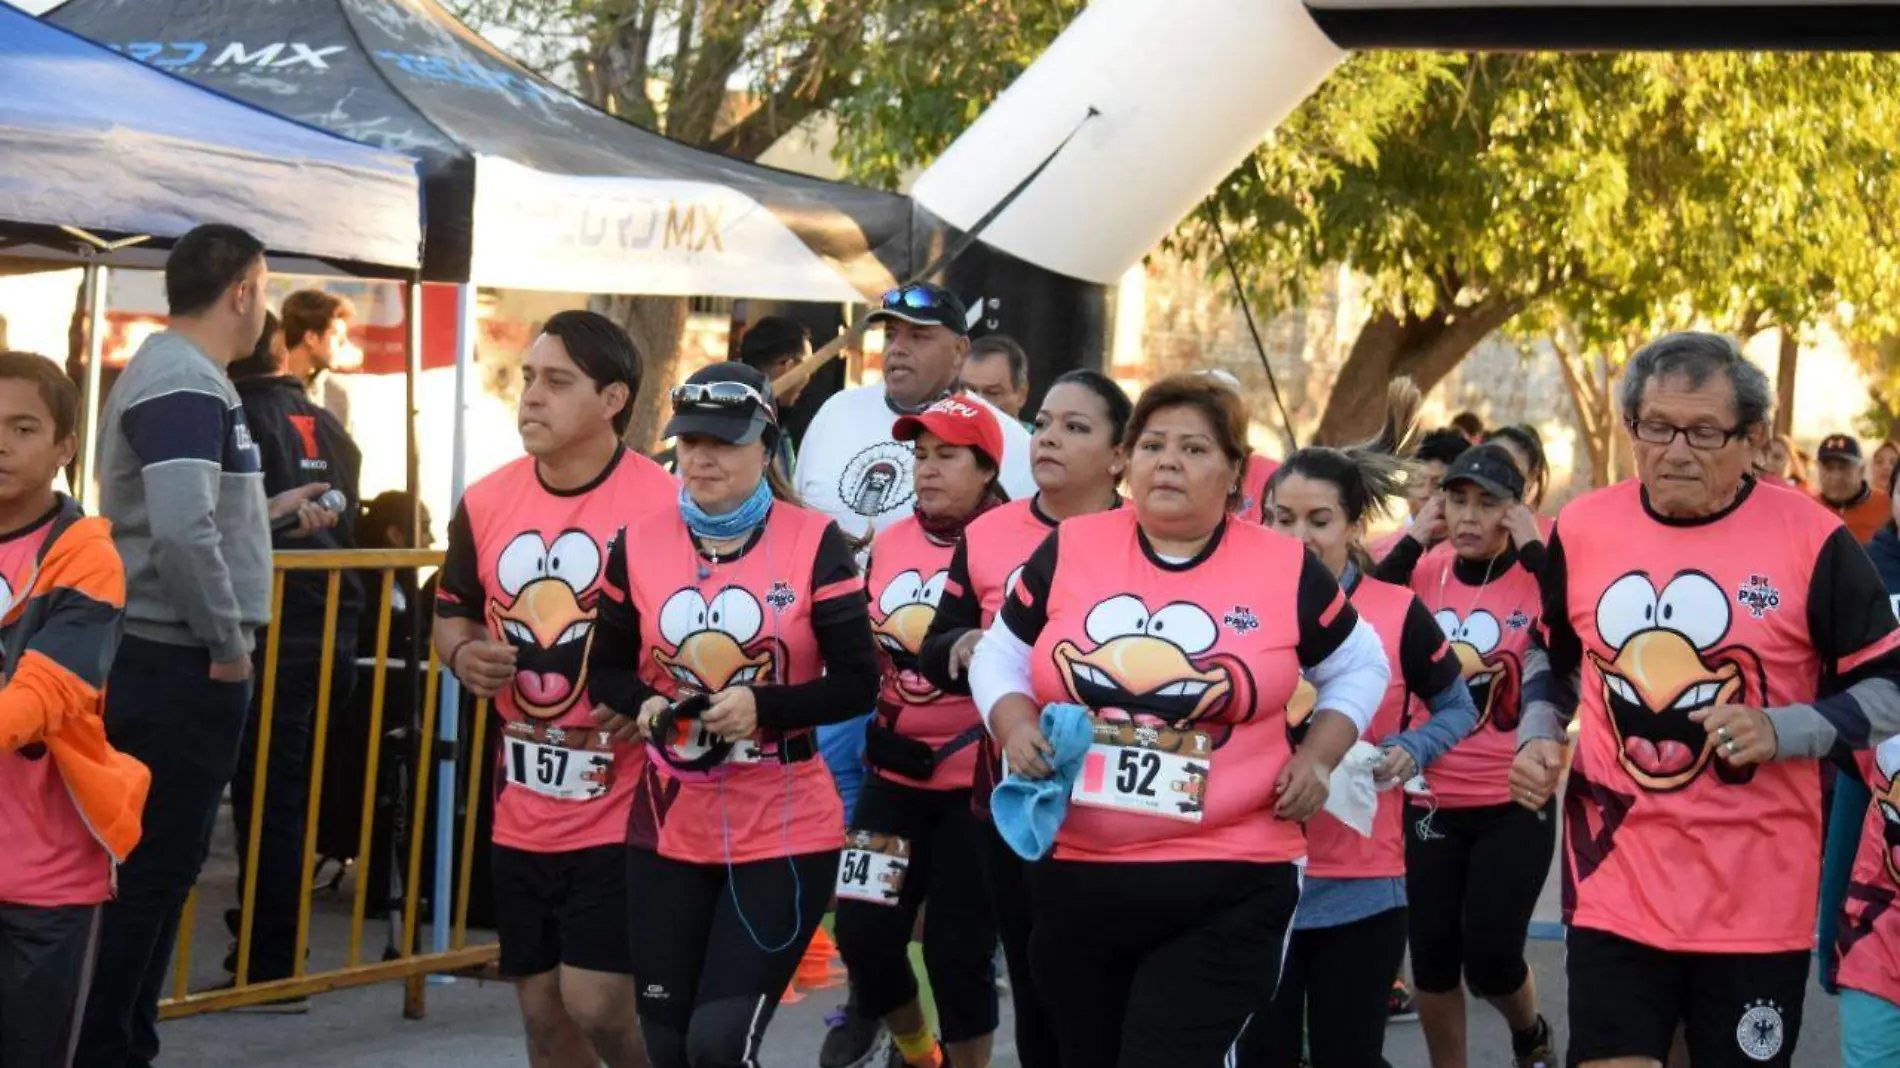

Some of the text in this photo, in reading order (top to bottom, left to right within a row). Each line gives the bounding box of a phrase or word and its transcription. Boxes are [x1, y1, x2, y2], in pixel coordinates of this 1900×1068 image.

[210, 42, 347, 69] MX
[663, 198, 724, 252] MX
[537, 746, 569, 786] 57
[1116, 749, 1161, 797] 52
[842, 851, 871, 886] 54
